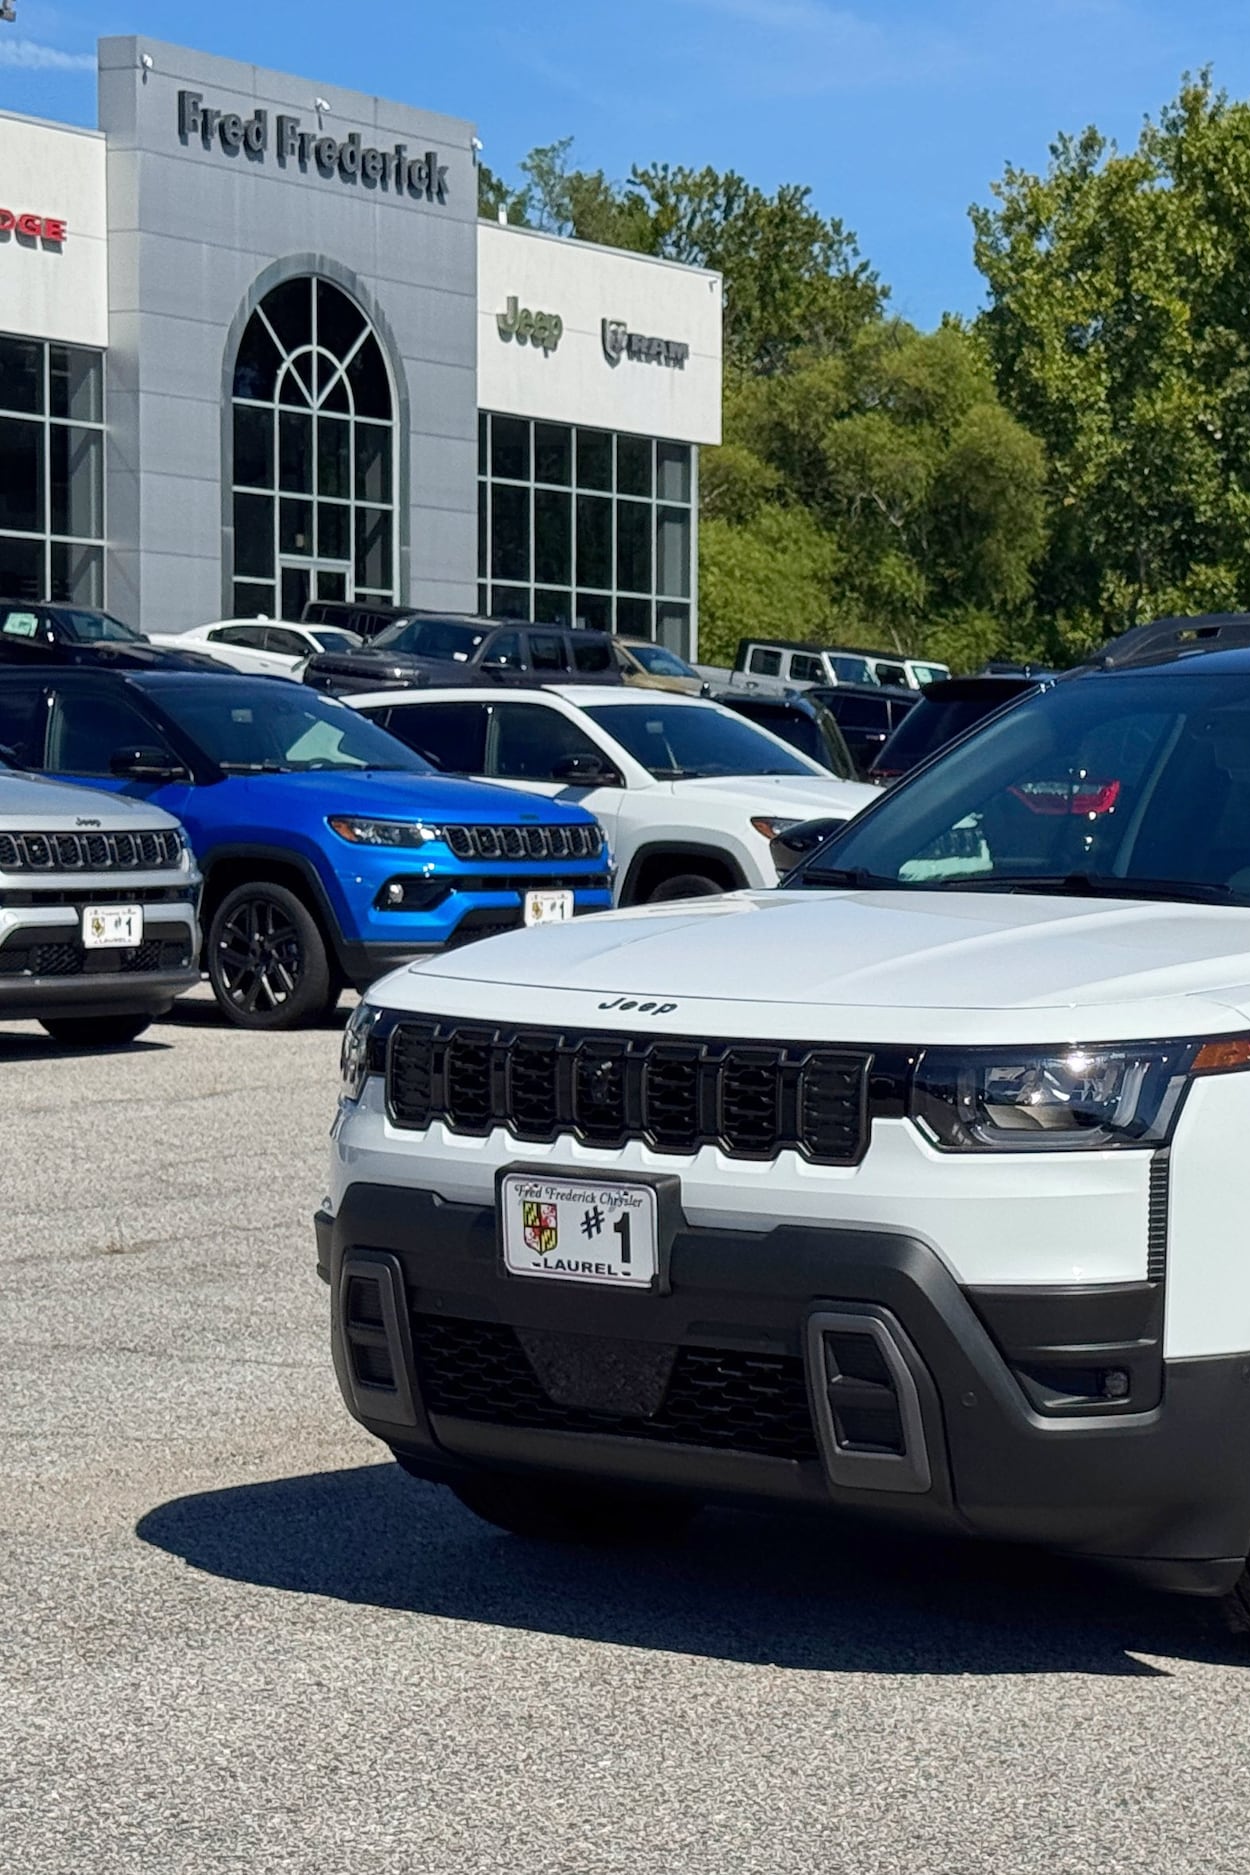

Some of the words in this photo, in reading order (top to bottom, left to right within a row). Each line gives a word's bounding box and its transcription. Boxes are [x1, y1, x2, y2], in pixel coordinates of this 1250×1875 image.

[177, 90, 268, 156] Fred
[275, 114, 449, 198] Frederick
[496, 296, 563, 352] Jeep
[627, 333, 689, 364] RAM
[598, 997, 678, 1015] Jeep
[514, 1182, 542, 1199] Fred
[545, 1186, 597, 1204] Frederick
[599, 1190, 643, 1212] Chrysler
[543, 1257, 618, 1276] LAUREL
